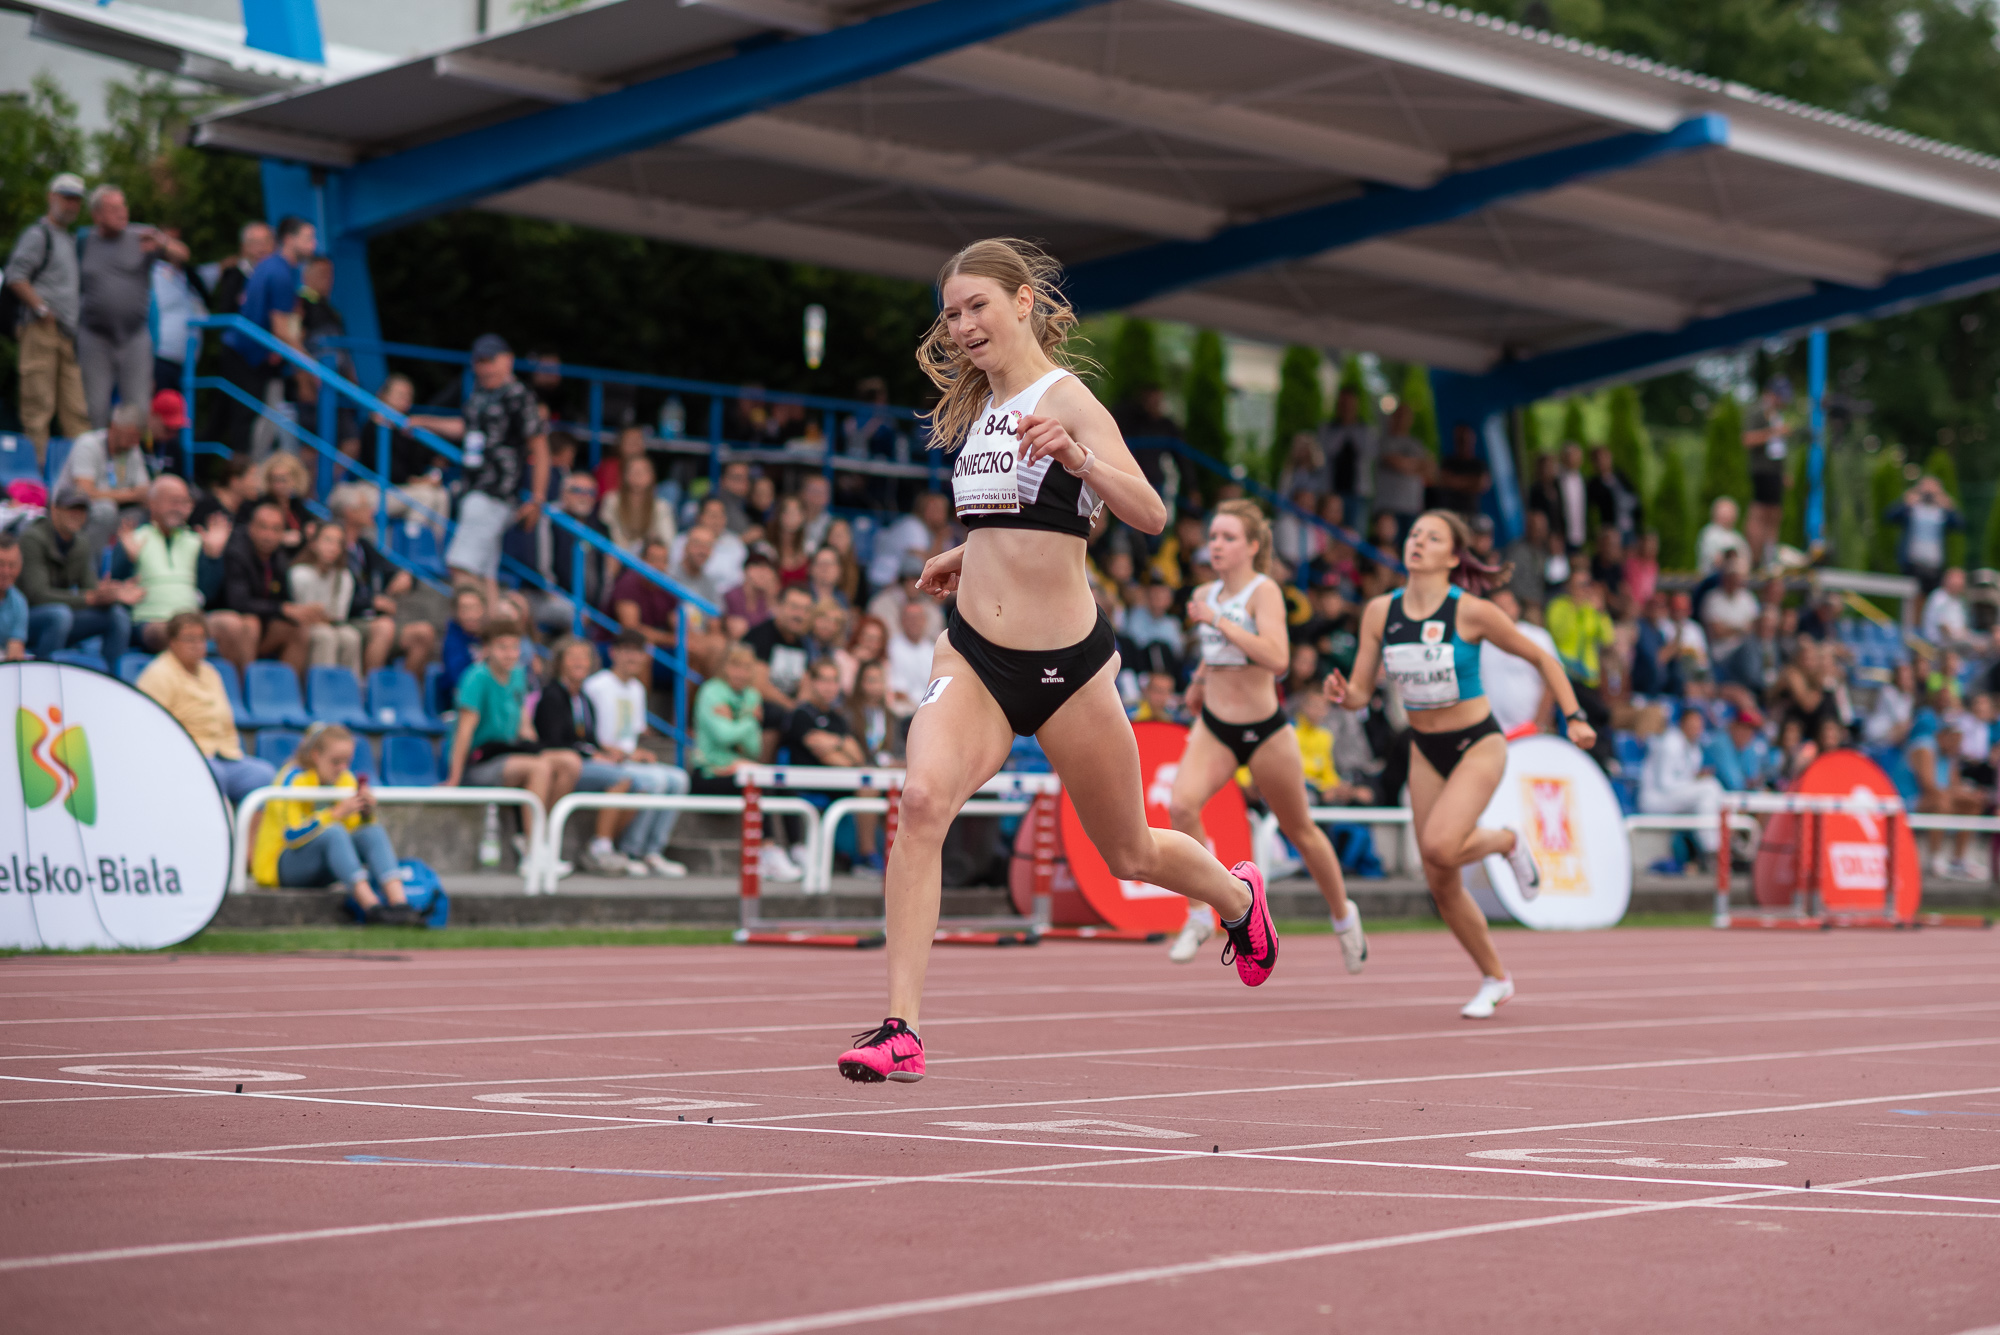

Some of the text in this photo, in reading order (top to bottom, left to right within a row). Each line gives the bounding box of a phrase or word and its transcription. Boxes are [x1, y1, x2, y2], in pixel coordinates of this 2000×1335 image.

[953, 451, 1014, 478] ONIECZKO
[981, 492, 1000, 500] Polski
[1001, 492, 1017, 500] U18
[1424, 647, 1442, 661] 67
[920, 679, 941, 703] 4
